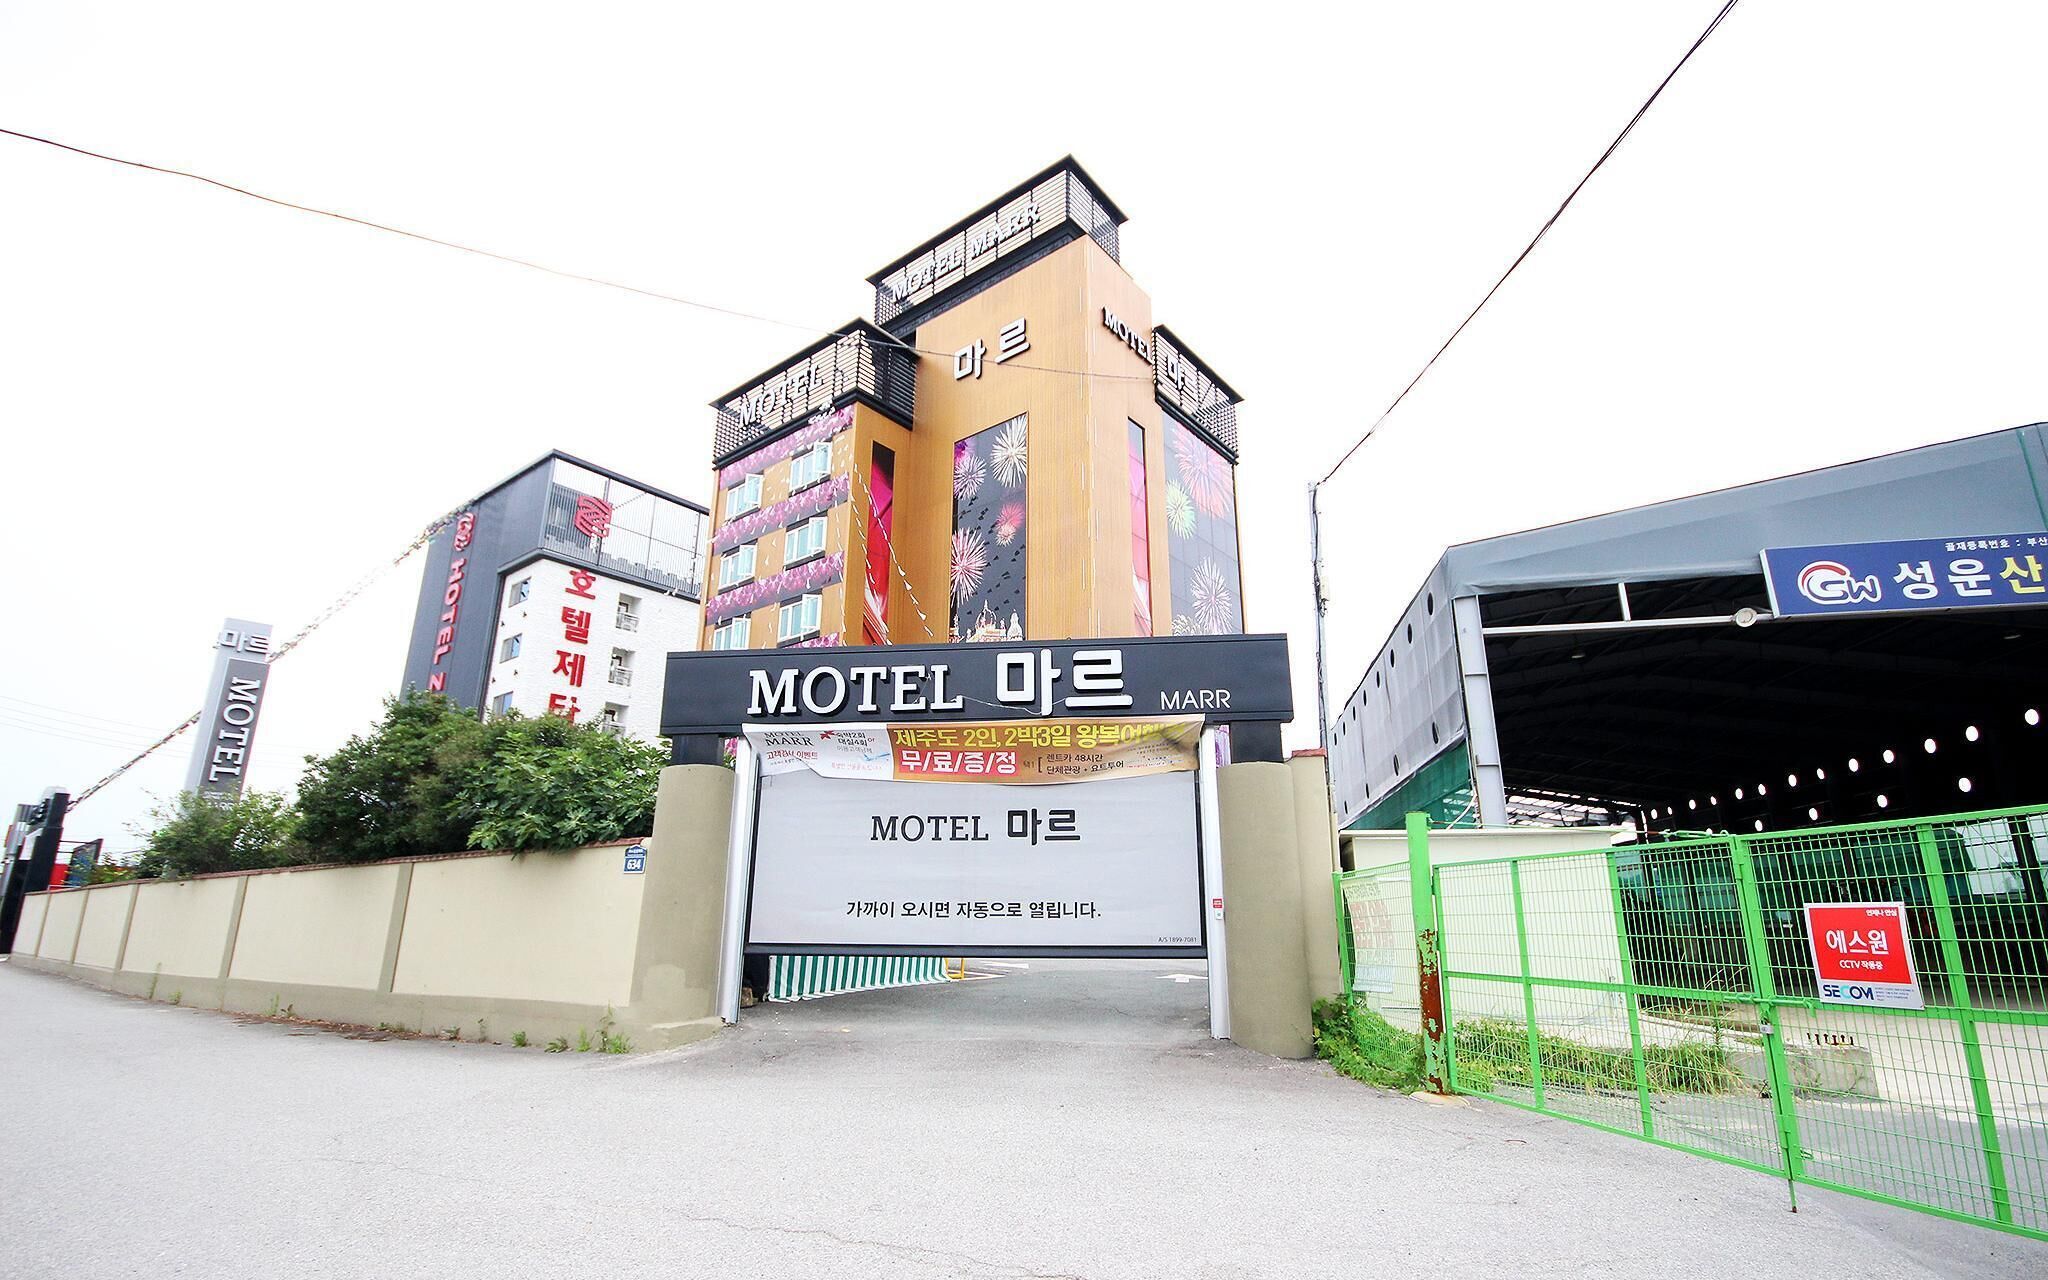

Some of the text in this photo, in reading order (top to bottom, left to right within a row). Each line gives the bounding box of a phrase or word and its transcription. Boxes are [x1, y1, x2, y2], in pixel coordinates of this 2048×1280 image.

[891, 202, 1041, 305] MOTEL MARR
[1101, 306, 1154, 366] MOTEL
[953, 317, 1031, 381] 마르
[740, 364, 824, 428] MOTEL
[434, 558, 467, 665] HOTEL
[221, 630, 270, 655] 마르
[747, 648, 1232, 716] MOTEL 마르 MARR
[209, 676, 261, 782] MOTEL
[894, 728, 961, 748] 제주도
[963, 728, 1001, 748] 2인,
[1004, 724, 1071, 748] 2박3일
[766, 737, 815, 747] MARR
[901, 750, 1017, 774] 무/료/증/정
[1074, 754, 1104, 762] 48시간
[870, 808, 1081, 846] MOTEL 마르
[627, 859, 643, 870] 634
[846, 901, 1102, 919] 가까이 오시면 자동으로 열립니다.
[1825, 929, 1889, 955] 에스원
[1839, 960, 1861, 969] CCTV
[1823, 984, 1875, 1001] SECOM
